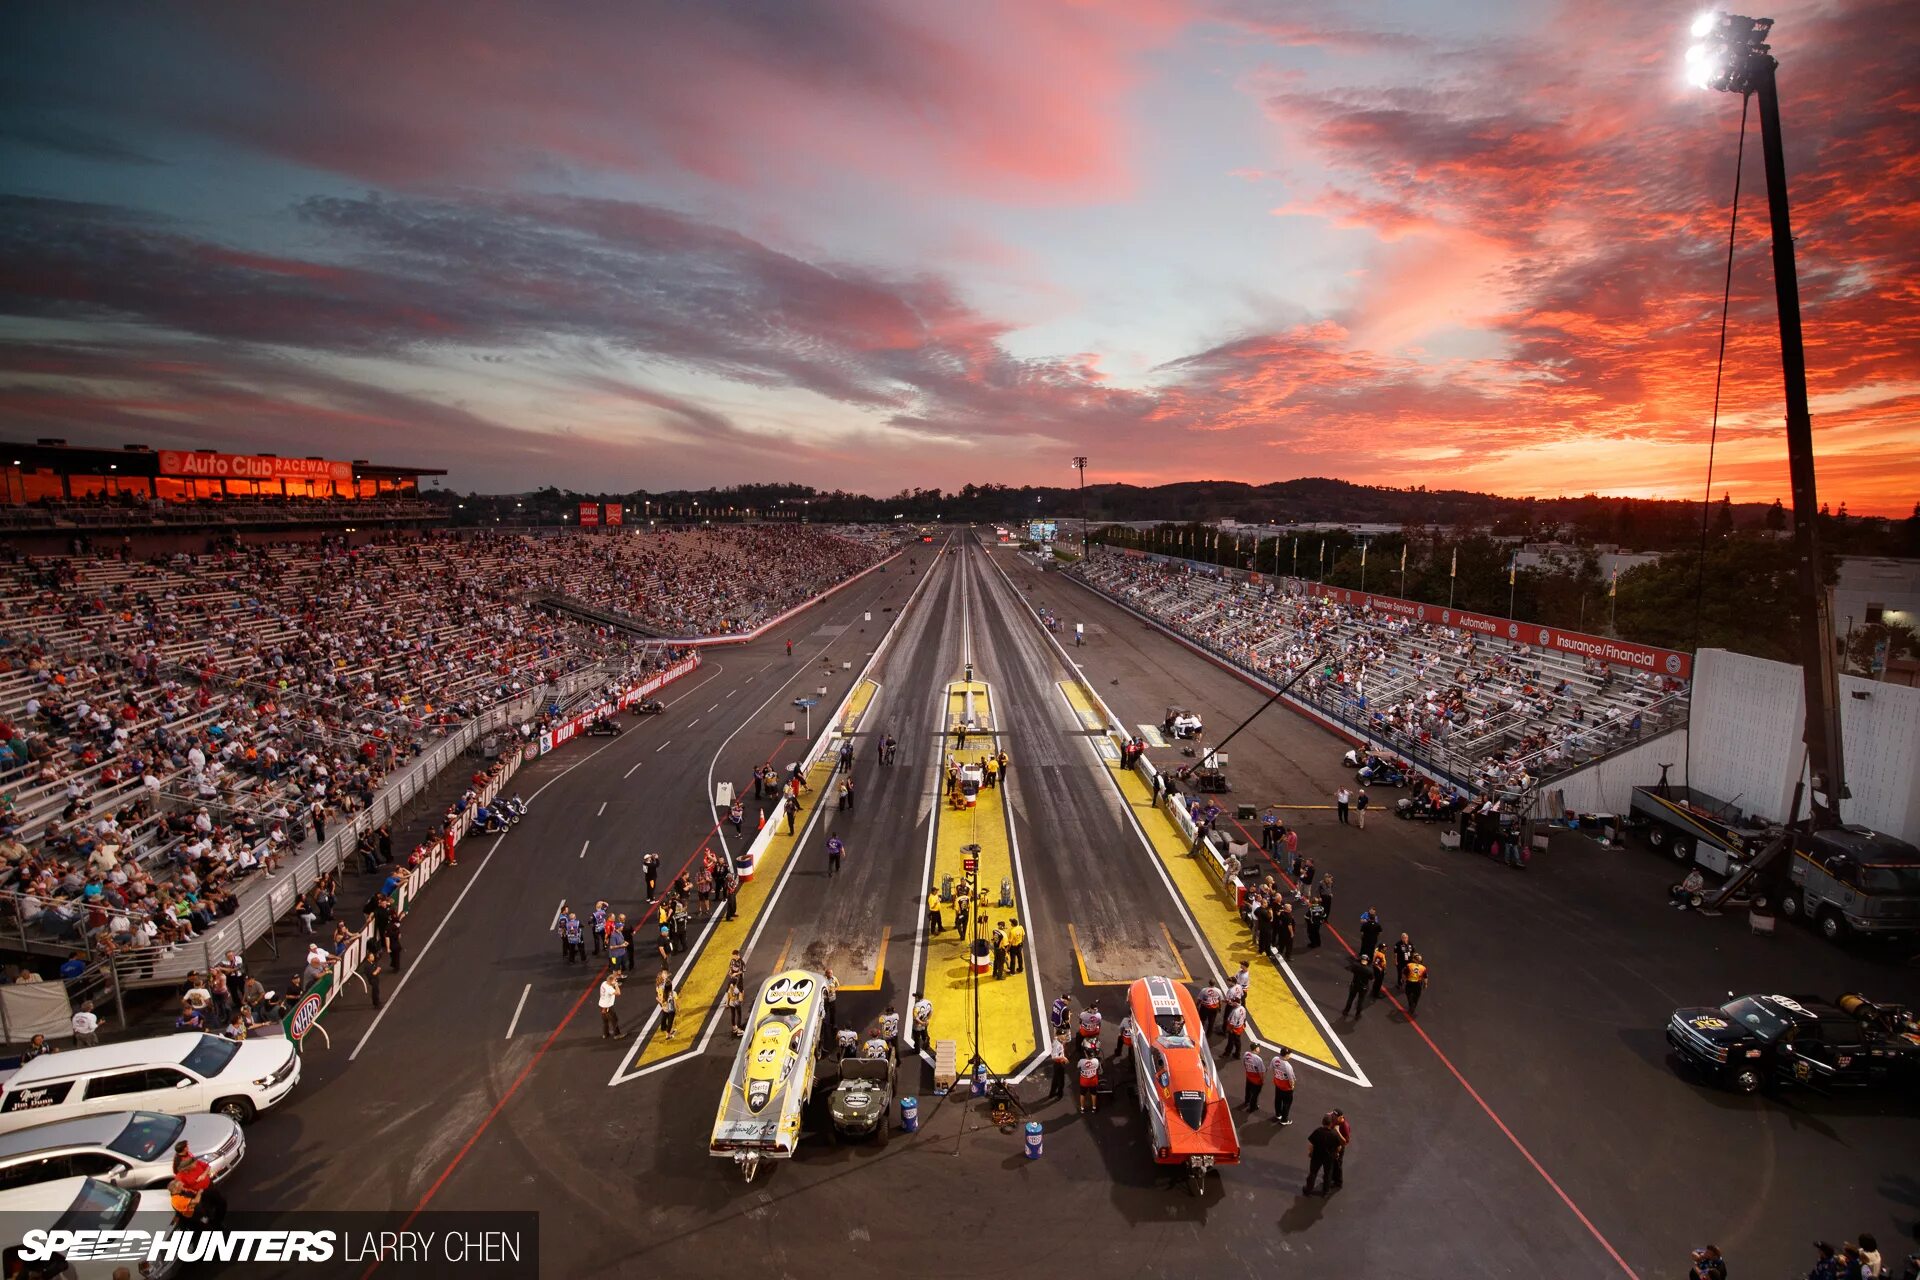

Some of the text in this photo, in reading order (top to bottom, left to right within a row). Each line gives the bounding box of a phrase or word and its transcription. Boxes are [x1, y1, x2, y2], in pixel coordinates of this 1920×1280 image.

[183, 454, 228, 474] Auto
[232, 456, 272, 475] Club
[275, 459, 330, 473] RACEWAY
[1373, 599, 1415, 614] Member Services
[1459, 616, 1497, 633] Automotive
[1557, 634, 1655, 667] Insurance/Financial
[557, 722, 576, 743] DON
[663, 660, 694, 684] GRANDSTAND
[325, 914, 380, 1003] JOH
[293, 998, 320, 1035] NHRA
[12, 1102, 28, 1111] Jim
[31, 1098, 53, 1107] Dunn
